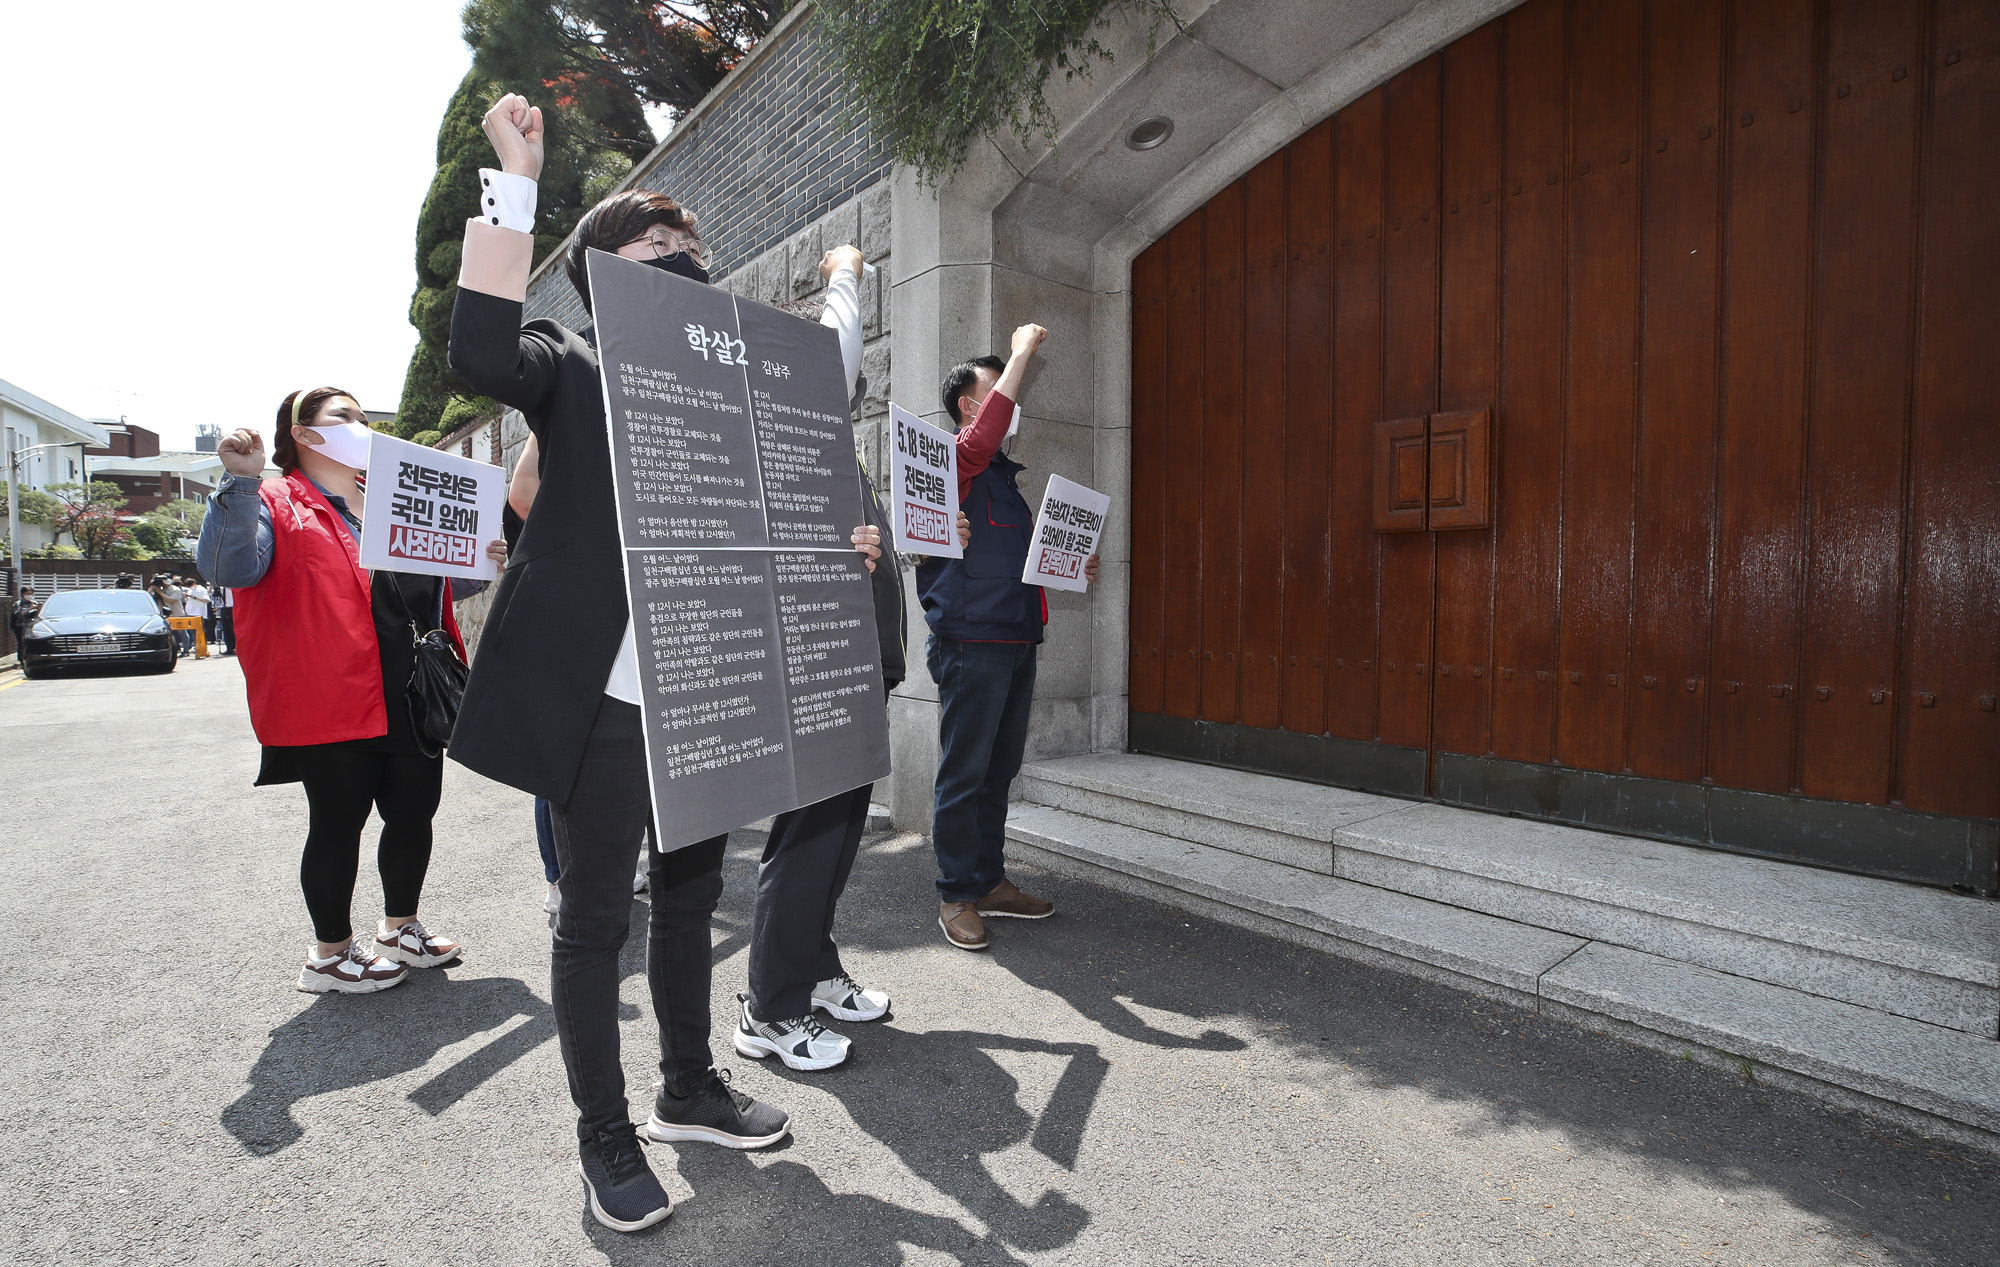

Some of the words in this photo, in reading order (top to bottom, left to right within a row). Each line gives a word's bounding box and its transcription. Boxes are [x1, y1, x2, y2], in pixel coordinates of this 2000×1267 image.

[684, 323, 749, 365] 학살2
[620, 363, 633, 374] 오월
[635, 366, 649, 376] 어느
[651, 369, 676, 382] 날이었다
[762, 360, 791, 380] 김남주
[670, 384, 682, 394] 오월
[684, 386, 697, 395] 어느
[622, 386, 636, 396] 광주
[686, 397, 698, 407] 오월
[700, 399, 712, 408] 어느
[713, 402, 718, 411] 날
[720, 403, 742, 415] 밤이었다
[625, 410, 632, 419] 밤
[634, 412, 648, 422] 12시
[650, 413, 663, 423] 나는
[665, 416, 684, 427] 보았다
[627, 422, 647, 433] 경찰이
[650, 424, 682, 436] 전투경찰로
[684, 430, 708, 440] 교체되는
[710, 433, 721, 442] 것을
[628, 433, 635, 443] 밤
[637, 435, 650, 445] 12시
[652, 436, 666, 446] 나는
[668, 439, 686, 449] 보았다
[629, 445, 664, 458] 전투경찰이
[666, 449, 692, 460] 군인들로
[693, 453, 717, 463] 교체되는
[718, 455, 730, 464] 것을
[898, 420, 917, 458] 5.18
[919, 432, 949, 472] 학살자
[631, 457, 638, 467] 밤
[641, 458, 653, 468] 12시
[656, 459, 668, 469] 나는
[671, 461, 690, 471] 보았다
[398, 461, 477, 504] 전두환은
[632, 469, 646, 479] 미국
[648, 470, 681, 482] 민간인들이
[683, 474, 701, 483] 도시를
[703, 475, 732, 486] 빠져나가는
[734, 478, 745, 487] 것을
[634, 481, 641, 490] 밤
[643, 482, 656, 492] 12시
[658, 482, 671, 492] 나는
[674, 484, 692, 494] 보았다
[905, 464, 946, 506] 전두환을
[635, 493, 656, 502] 도시로
[658, 494, 684, 504] 들어오는
[687, 496, 698, 505] 모든
[701, 496, 724, 506] 차량들이
[726, 498, 747, 508] 차단되는
[749, 500, 760, 509] 것을
[392, 493, 434, 527] 국민
[439, 504, 479, 535] 앞에
[638, 516, 645, 526] 아
[648, 517, 668, 527] 얼마나
[670, 518, 689, 527] 음산한
[690, 518, 696, 527] 밤
[699, 519, 728, 528] 12시였던가
[906, 504, 949, 543] 처벌하라
[1045, 497, 1071, 523] 학살자
[1069, 506, 1102, 533] 전두환이
[640, 528, 646, 538] 아
[649, 529, 669, 538] 얼마나
[671, 529, 696, 539] 계획적인
[698, 530, 704, 539] 밤
[707, 529, 735, 539] 12시였던가
[1039, 525, 1067, 549] 있어야
[1065, 531, 1076, 551] 할
[1074, 534, 1093, 555] 곳은
[391, 527, 475, 565] 사죄하라
[643, 554, 656, 564] 오월
[658, 554, 672, 564] 어느
[673, 554, 699, 563] 날이었다
[1040, 549, 1080, 578] 감옥이다
[692, 565, 705, 574] 오월
[706, 565, 719, 574] 어느
[720, 565, 743, 574] 날이었다
[645, 578, 659, 588] 광주
[708, 576, 720, 585] 오월
[721, 576, 733, 585] 어느
[735, 575, 740, 584] 날
[742, 575, 763, 584] 밤이었다
[648, 602, 655, 612] 밤
[657, 601, 670, 612] 12시
[672, 601, 685, 610] 나는
[688, 599, 706, 610] 보았다
[650, 613, 677, 624] 총검으로
[679, 611, 698, 621] 무장한
[700, 609, 718, 620] 일단의
[720, 608, 743, 618] 군인들을
[651, 626, 658, 636] 밤
[660, 624, 673, 634] 12시
[675, 624, 688, 633] 나는
[691, 621, 709, 632] 보았다
[652, 636, 679, 647] 야만족의
[682, 634, 707, 644] 침략과도
[709, 632, 721, 642] 같은
[723, 630, 740, 640] 일단의
[742, 628, 763, 638] 군인들을
[654, 650, 661, 660] 밤
[663, 648, 676, 658] 12시
[678, 647, 691, 656] 나는
[693, 644, 712, 654] 보았다
[656, 659, 682, 671] 이민족의
[685, 656, 710, 667] 약탈과도
[712, 655, 723, 664] 같은
[725, 652, 742, 662] 일단의
[744, 649, 765, 660] 군인들을
[657, 674, 664, 684] 밤
[666, 671, 679, 681] 12시
[681, 670, 694, 680] 나는
[696, 667, 714, 677] 보았다
[658, 683, 678, 695] 악마의
[681, 680, 707, 691] 화신과도
[708, 678, 720, 687] 같은
[722, 674, 739, 685] 일단의
[741, 671, 763, 682] 군인들을
[661, 709, 668, 719] 아
[670, 706, 690, 718] 얼마나
[692, 702, 711, 714] 무서운
[713, 700, 719, 710] 밤
[721, 695, 749, 708] 12시였던가
[663, 721, 670, 731] 아
[672, 717, 692, 729] 얼마나
[694, 712, 718, 724] 노골적인
[720, 711, 726, 720] 밤
[728, 705, 756, 718] 12시였던가
[666, 744, 679, 754] 오월
[681, 742, 695, 751] 어느
[696, 735, 721, 748] 날이었다
[715, 745, 726, 755] 오월
[728, 743, 740, 752] 어느
[741, 736, 764, 749] 날이었다
[669, 768, 682, 779] 광주
[730, 753, 741, 763] 오월
[743, 751, 754, 760] 어느
[755, 748, 761, 757] 날
[762, 743, 783, 755] 밤이었다
